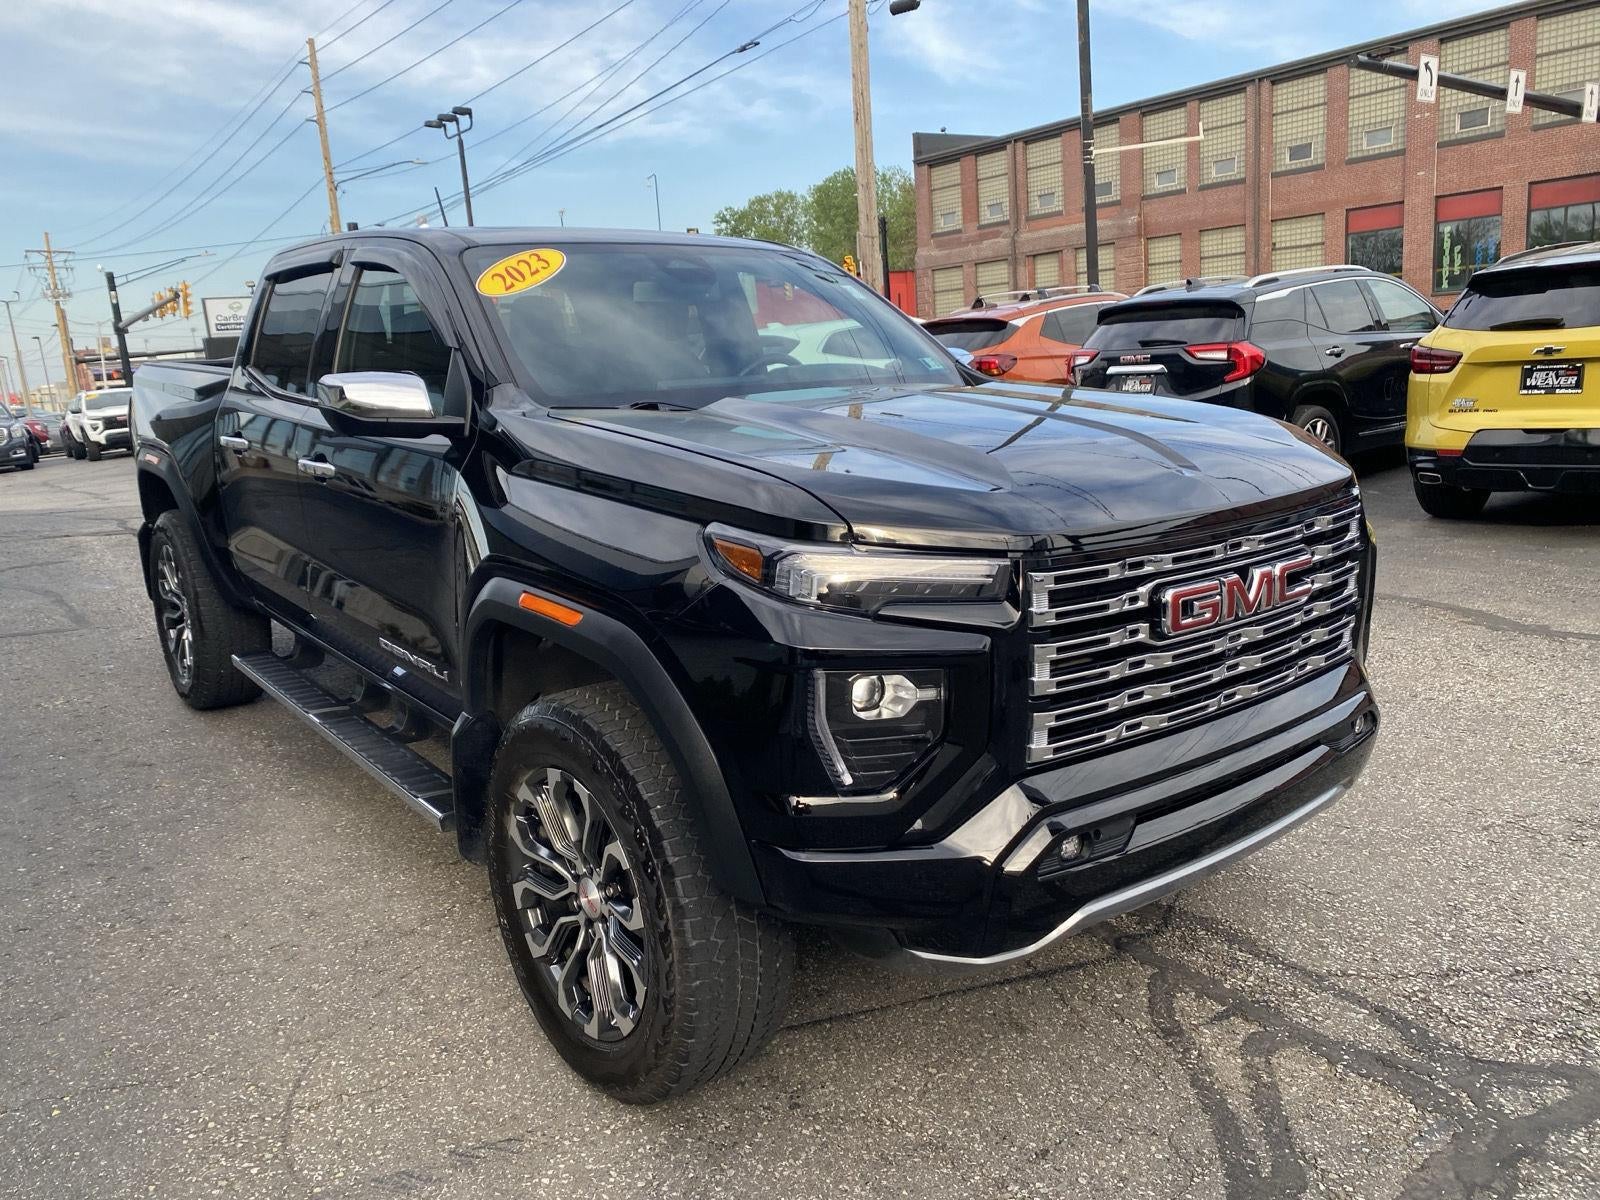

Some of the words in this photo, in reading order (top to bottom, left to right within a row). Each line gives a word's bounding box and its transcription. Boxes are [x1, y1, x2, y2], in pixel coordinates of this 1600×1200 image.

[1419, 88, 1434, 98] ONLY
[491, 252, 550, 292] 2023
[1120, 354, 1151, 364] GMC
[1532, 370, 1557, 380] RICK
[1526, 376, 1578, 386] WEAVER
[1164, 555, 1313, 636] GMC
[379, 637, 449, 682] DENALI
